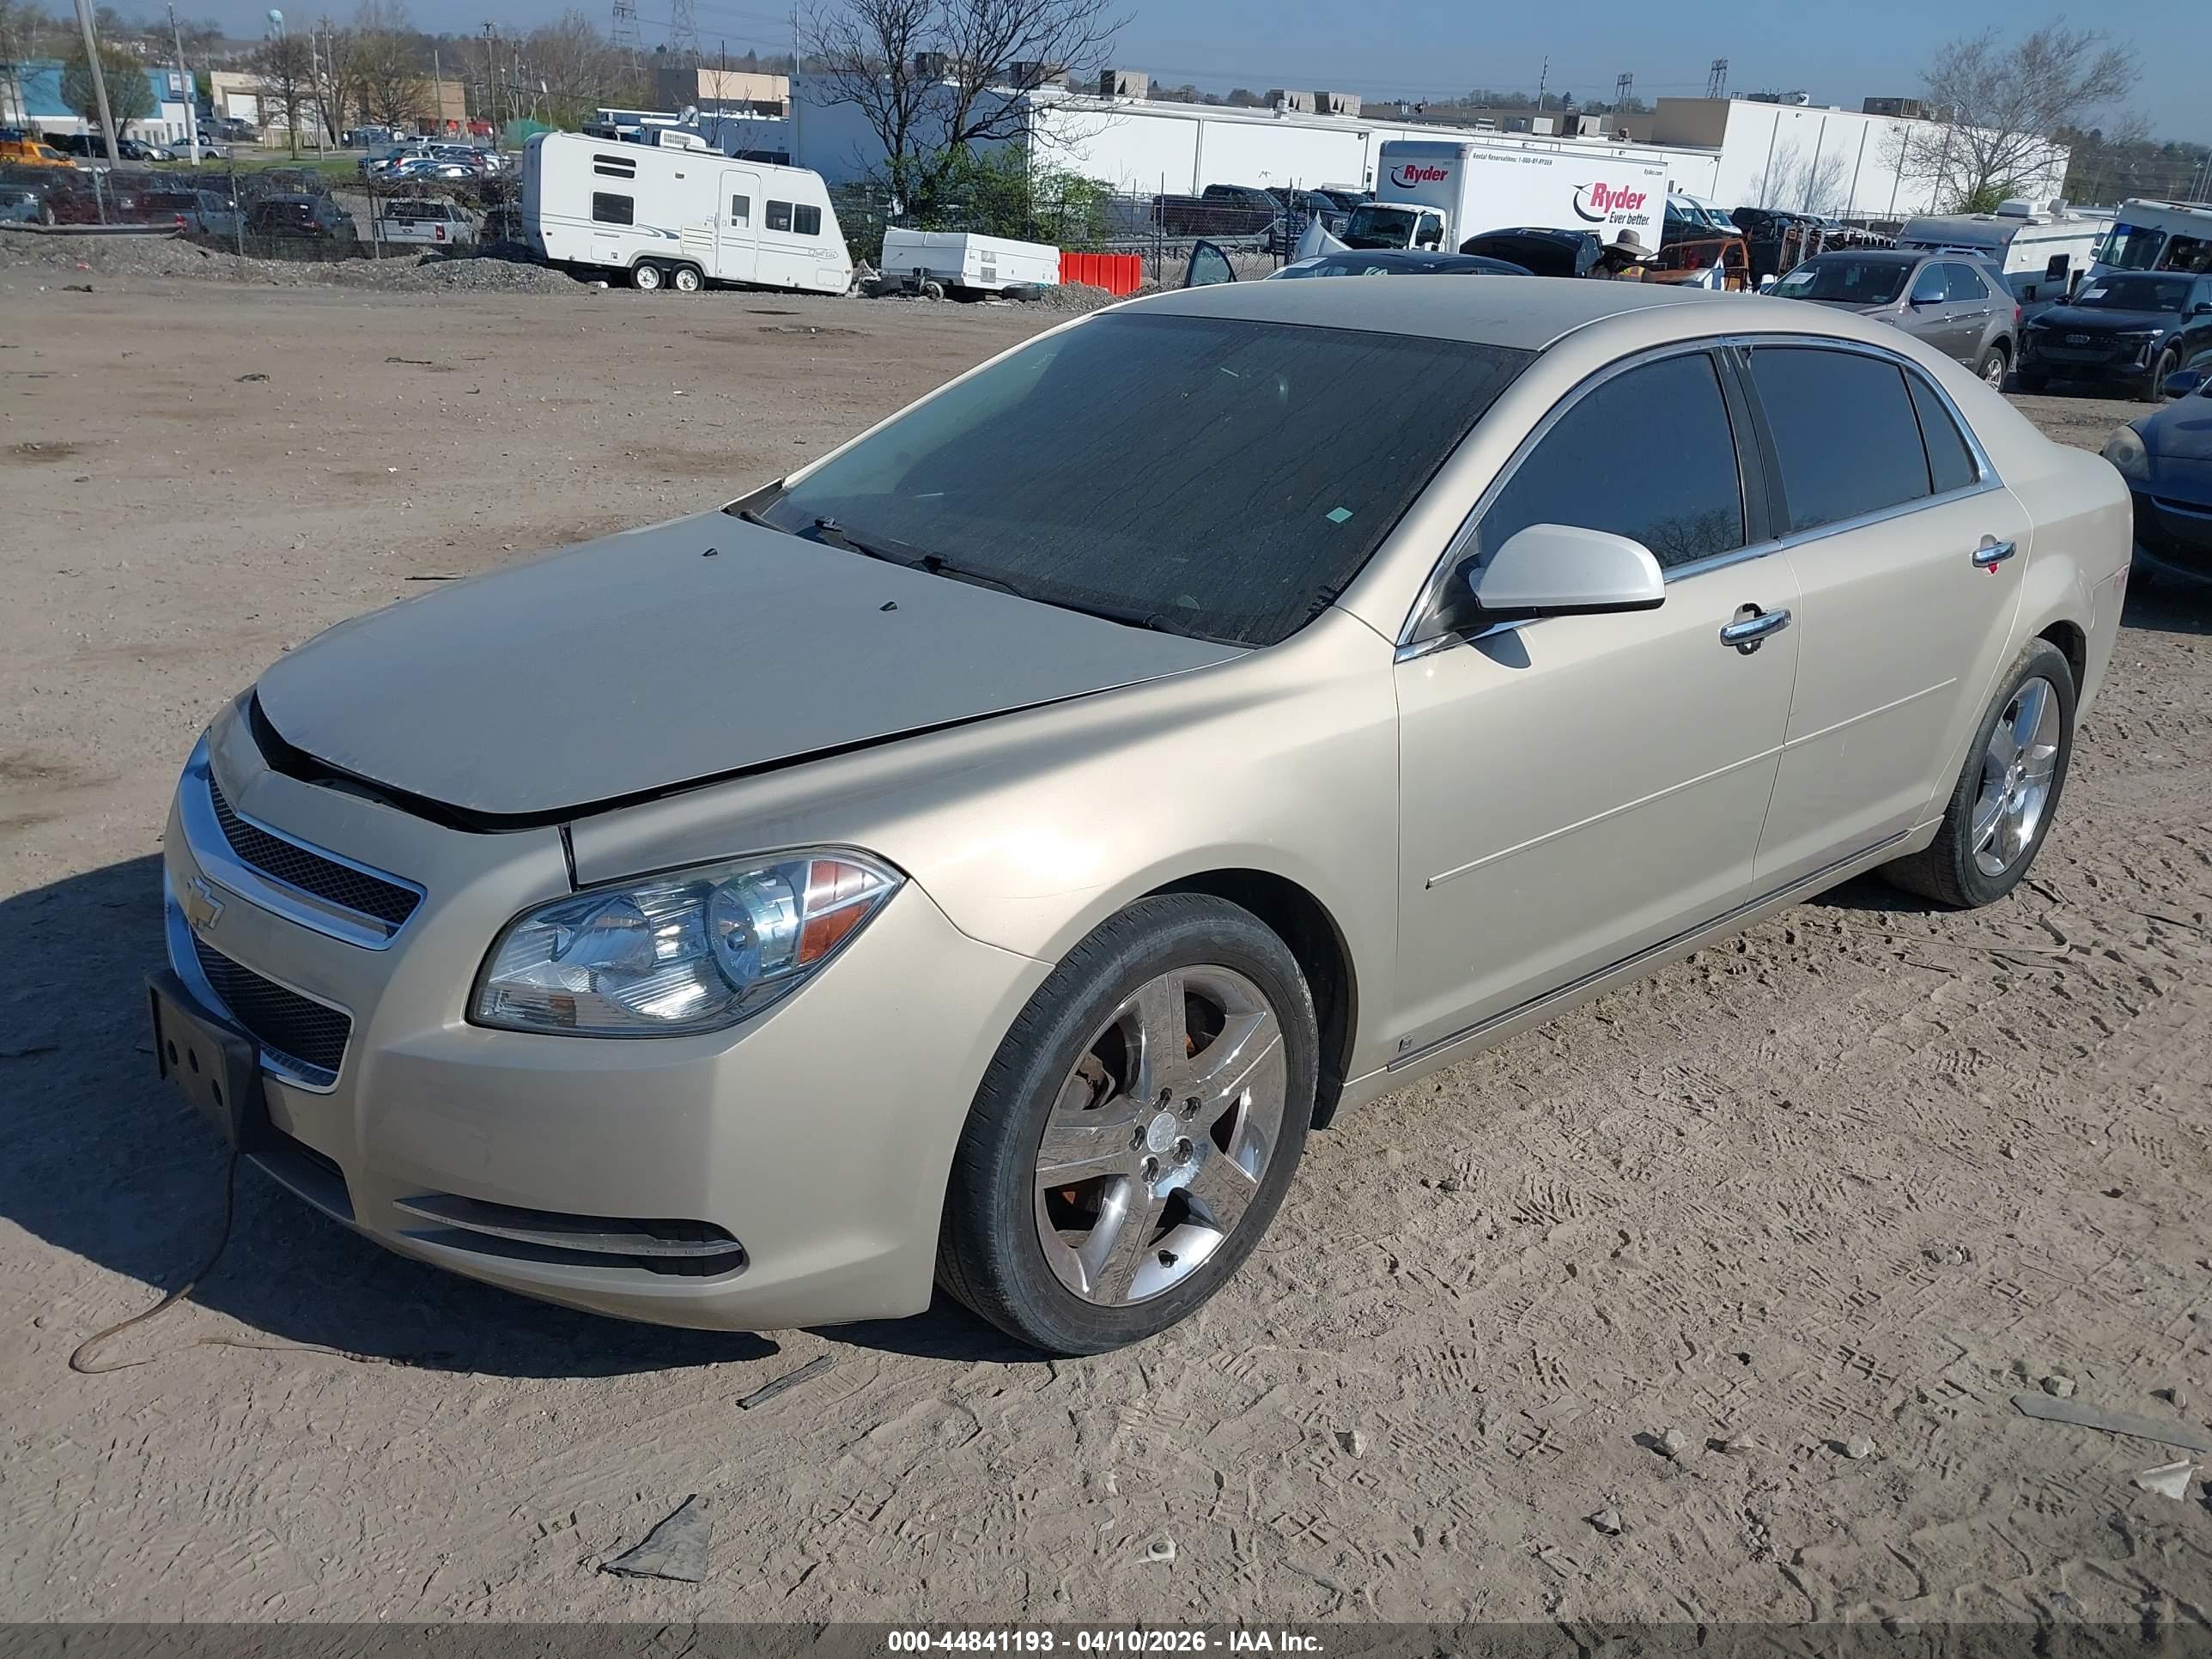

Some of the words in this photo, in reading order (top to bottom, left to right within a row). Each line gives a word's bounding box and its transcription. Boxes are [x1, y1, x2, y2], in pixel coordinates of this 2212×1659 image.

[1403, 164, 1448, 184] Ryder
[1590, 183, 1647, 214] Ryder
[1609, 211, 1626, 223] Ever
[1627, 214, 1650, 226] better.
